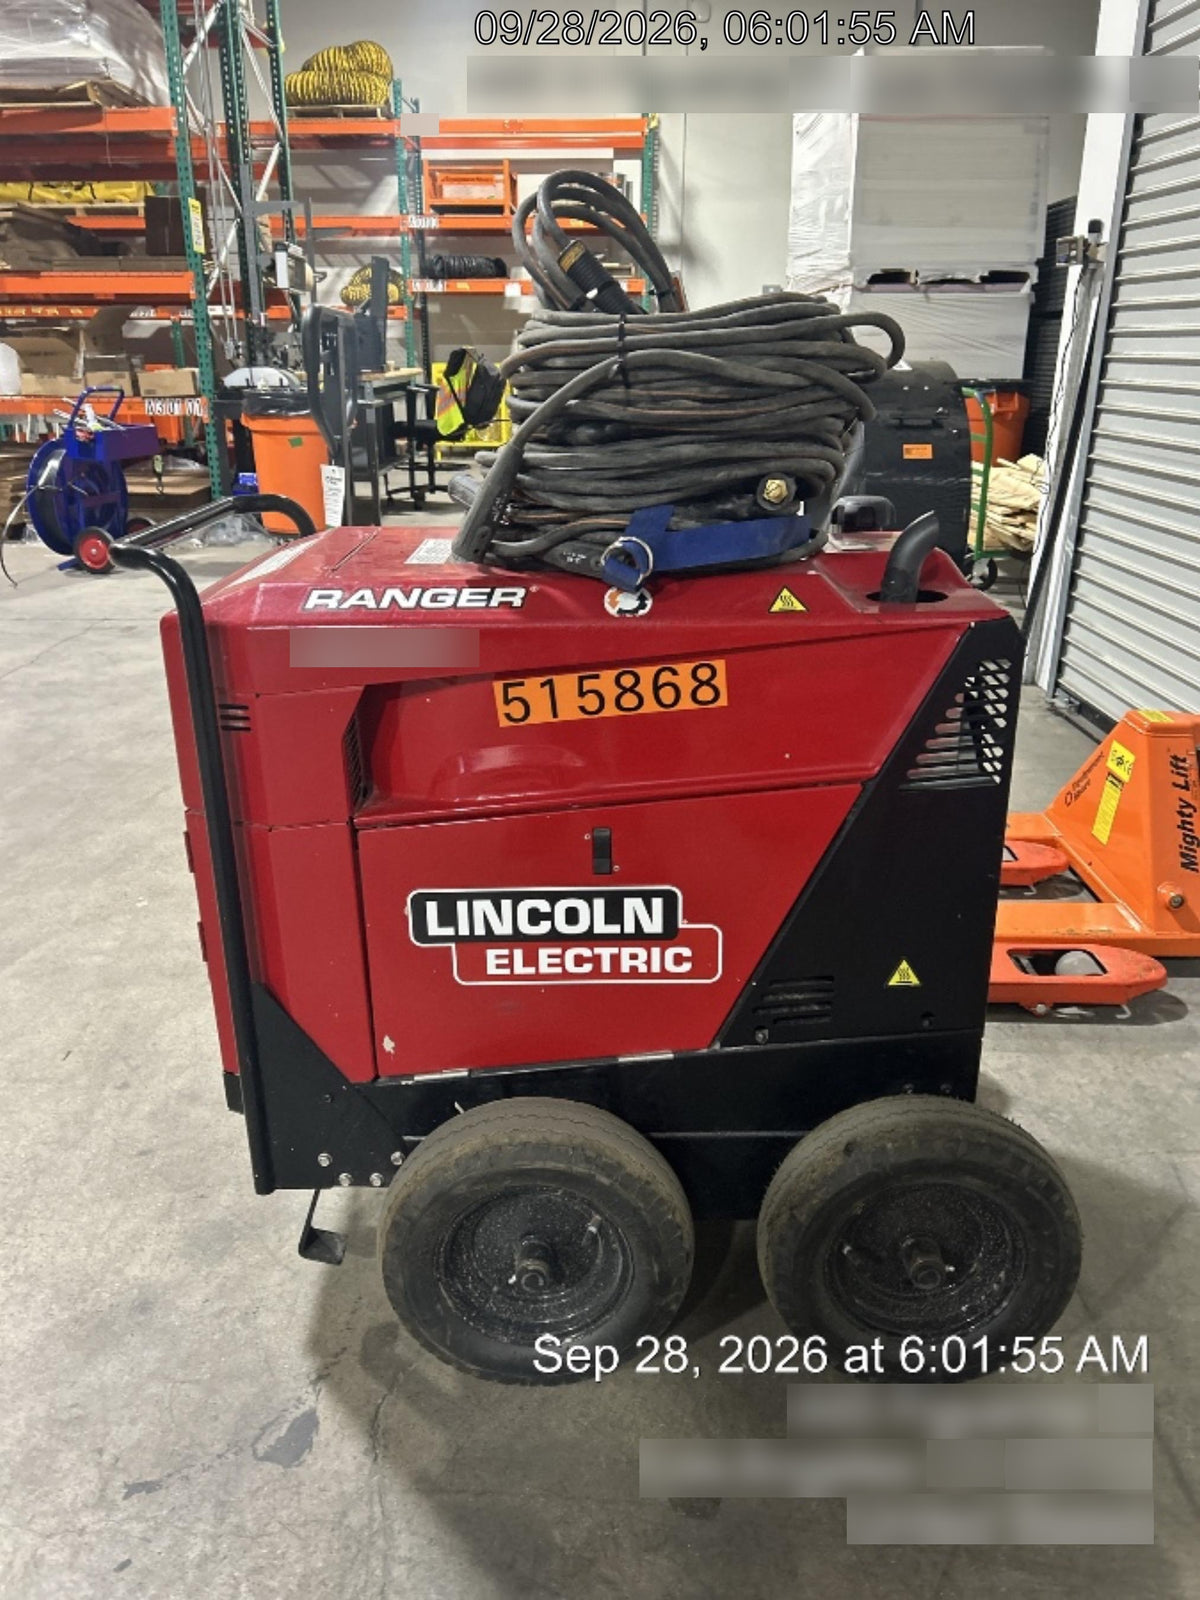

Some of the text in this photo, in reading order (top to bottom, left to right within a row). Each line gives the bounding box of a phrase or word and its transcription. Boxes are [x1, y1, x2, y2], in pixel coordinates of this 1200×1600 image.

[304, 586, 527, 611] RANGER
[501, 661, 723, 723] 515868
[1169, 754, 1190, 791] Lift
[1176, 797, 1200, 873] Mighty
[425, 897, 664, 936] LINCOLN
[486, 947, 692, 975] ELECTRIC
